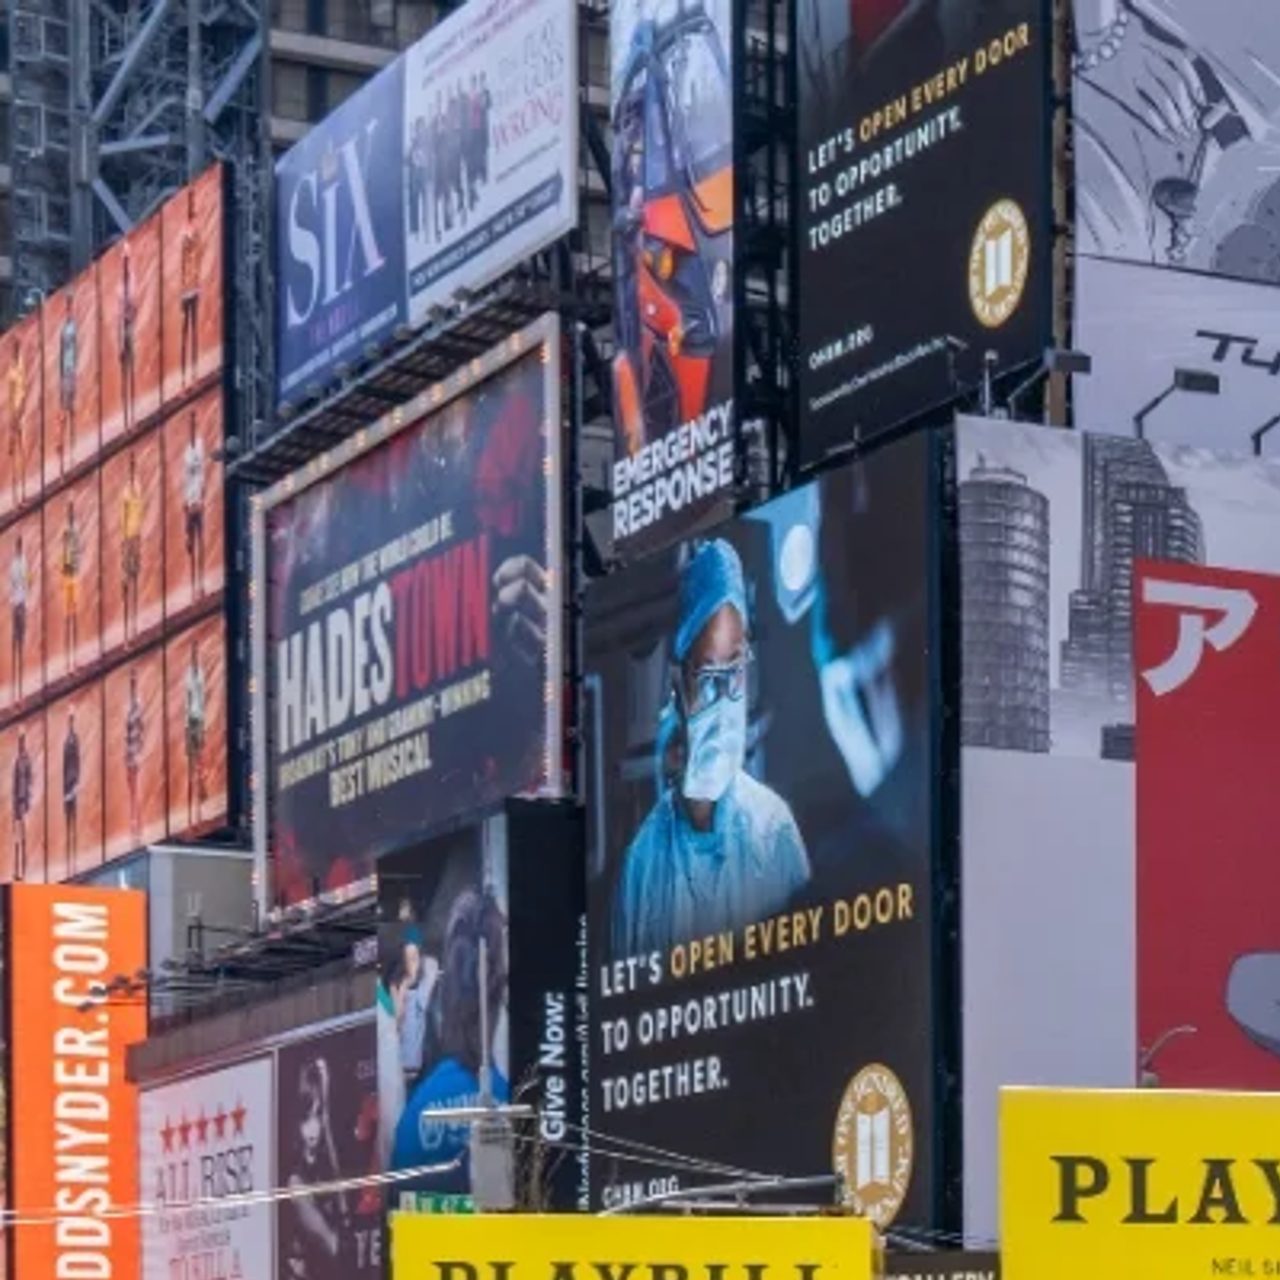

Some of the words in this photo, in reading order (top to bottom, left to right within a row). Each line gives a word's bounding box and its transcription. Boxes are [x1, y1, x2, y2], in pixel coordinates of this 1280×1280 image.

[807, 127, 856, 174] LET'S
[859, 96, 907, 143] OPEN
[911, 60, 968, 113] EVERY
[974, 22, 1030, 76] DOOR
[807, 180, 830, 213] TO
[834, 104, 964, 198] OPPORTUNITY.
[286, 118, 386, 328] SIX
[807, 182, 903, 252] TOGETHER.
[612, 400, 733, 494] EMERGENCY
[612, 443, 733, 540] RESPONSE
[277, 532, 490, 755] HADESTOWN
[600, 951, 662, 998] LET'S
[669, 929, 735, 979] OPEN
[743, 904, 824, 961] EVERY
[832, 882, 914, 938] DOOR
[601, 1018, 630, 1055] TO
[637, 971, 815, 1046] OPPORTUNITY.
[538, 1079, 567, 1142] Give
[601, 1055, 729, 1112] TOGETHER.
[199, 1144, 255, 1200] RISE
[1211, 1258, 1257, 1277] NEIL
